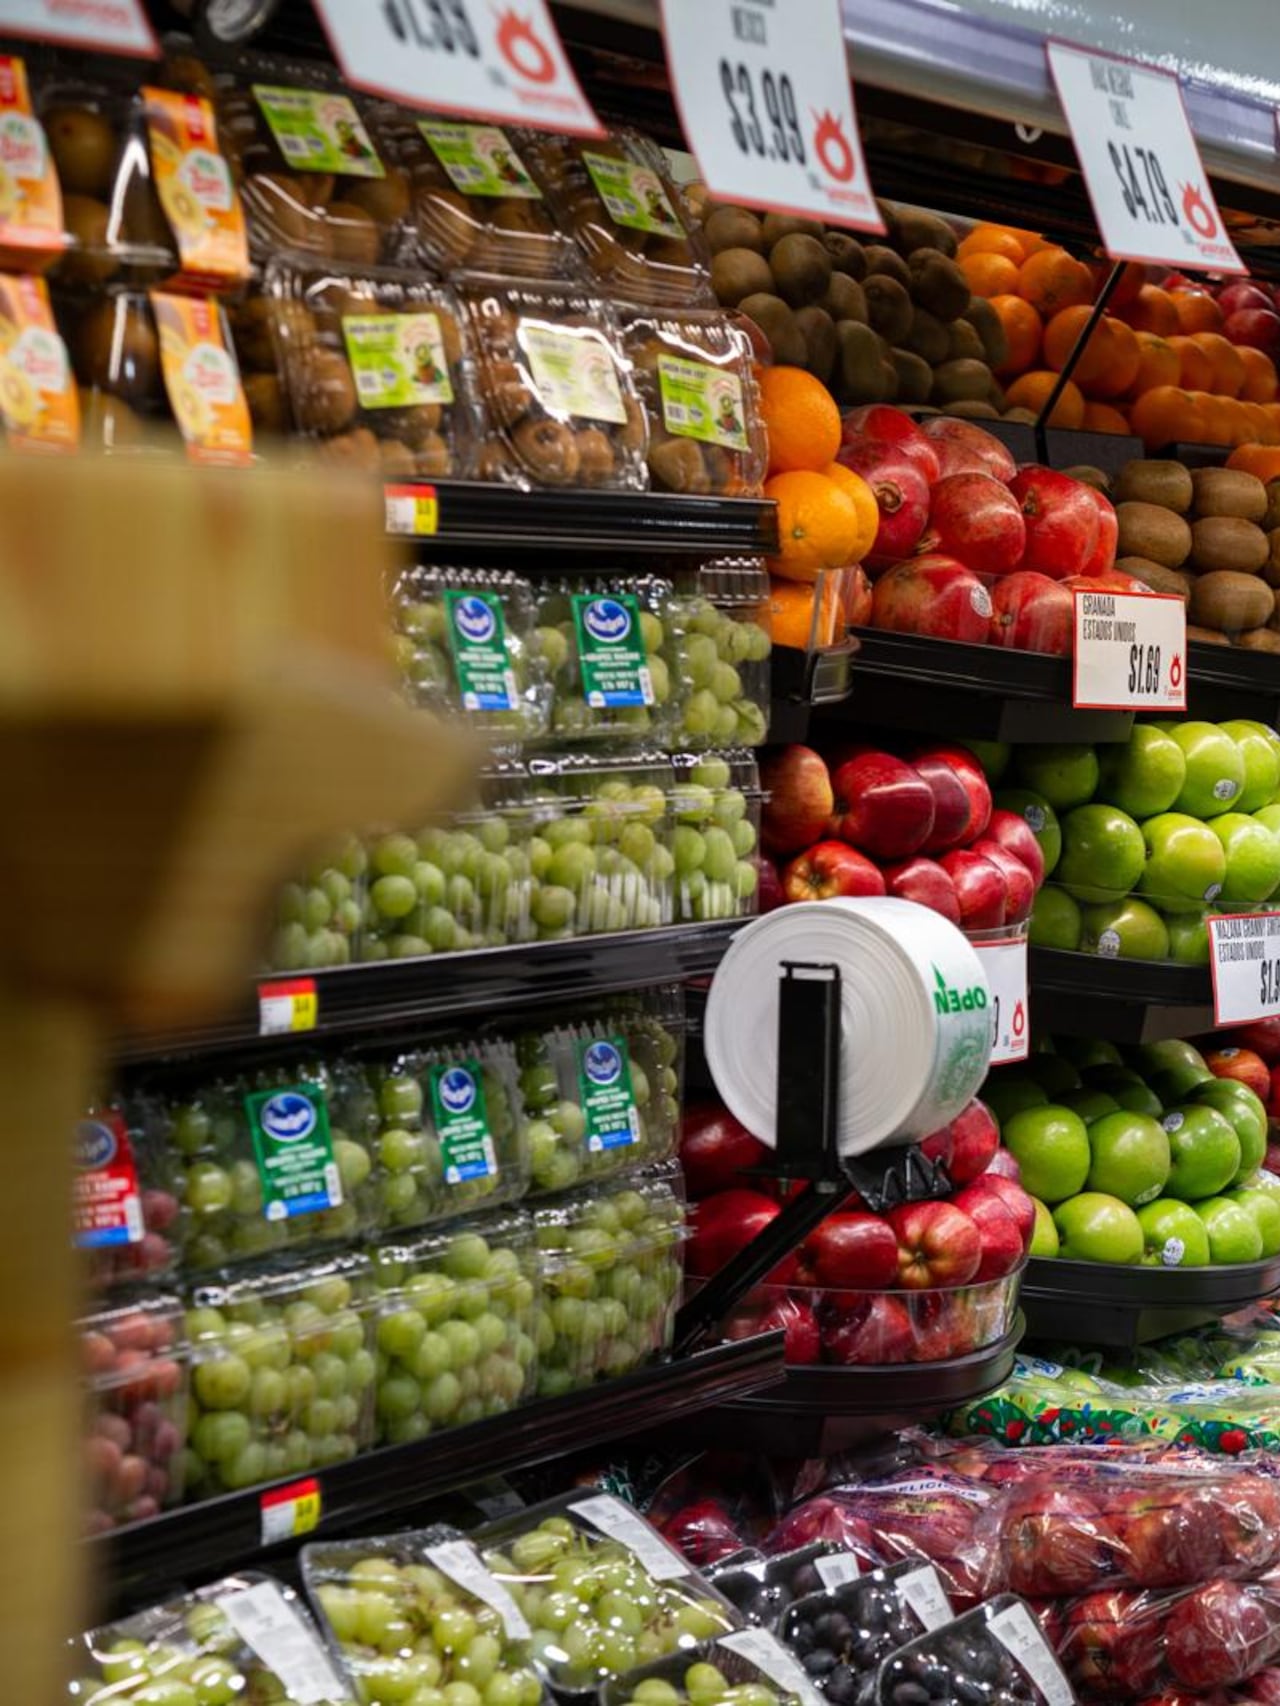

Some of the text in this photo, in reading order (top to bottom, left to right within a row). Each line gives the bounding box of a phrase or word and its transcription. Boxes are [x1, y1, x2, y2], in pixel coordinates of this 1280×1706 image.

[719, 57, 806, 166] $3.99
[1107, 140, 1179, 226] $4.79
[1083, 594, 1115, 616] GRANADA
[1083, 619, 1136, 642] ESTADOS UNIDOS
[1128, 644, 1160, 694] $1.69
[1219, 942, 1245, 962] ESTADOS
[934, 986, 987, 1014] OPEN
